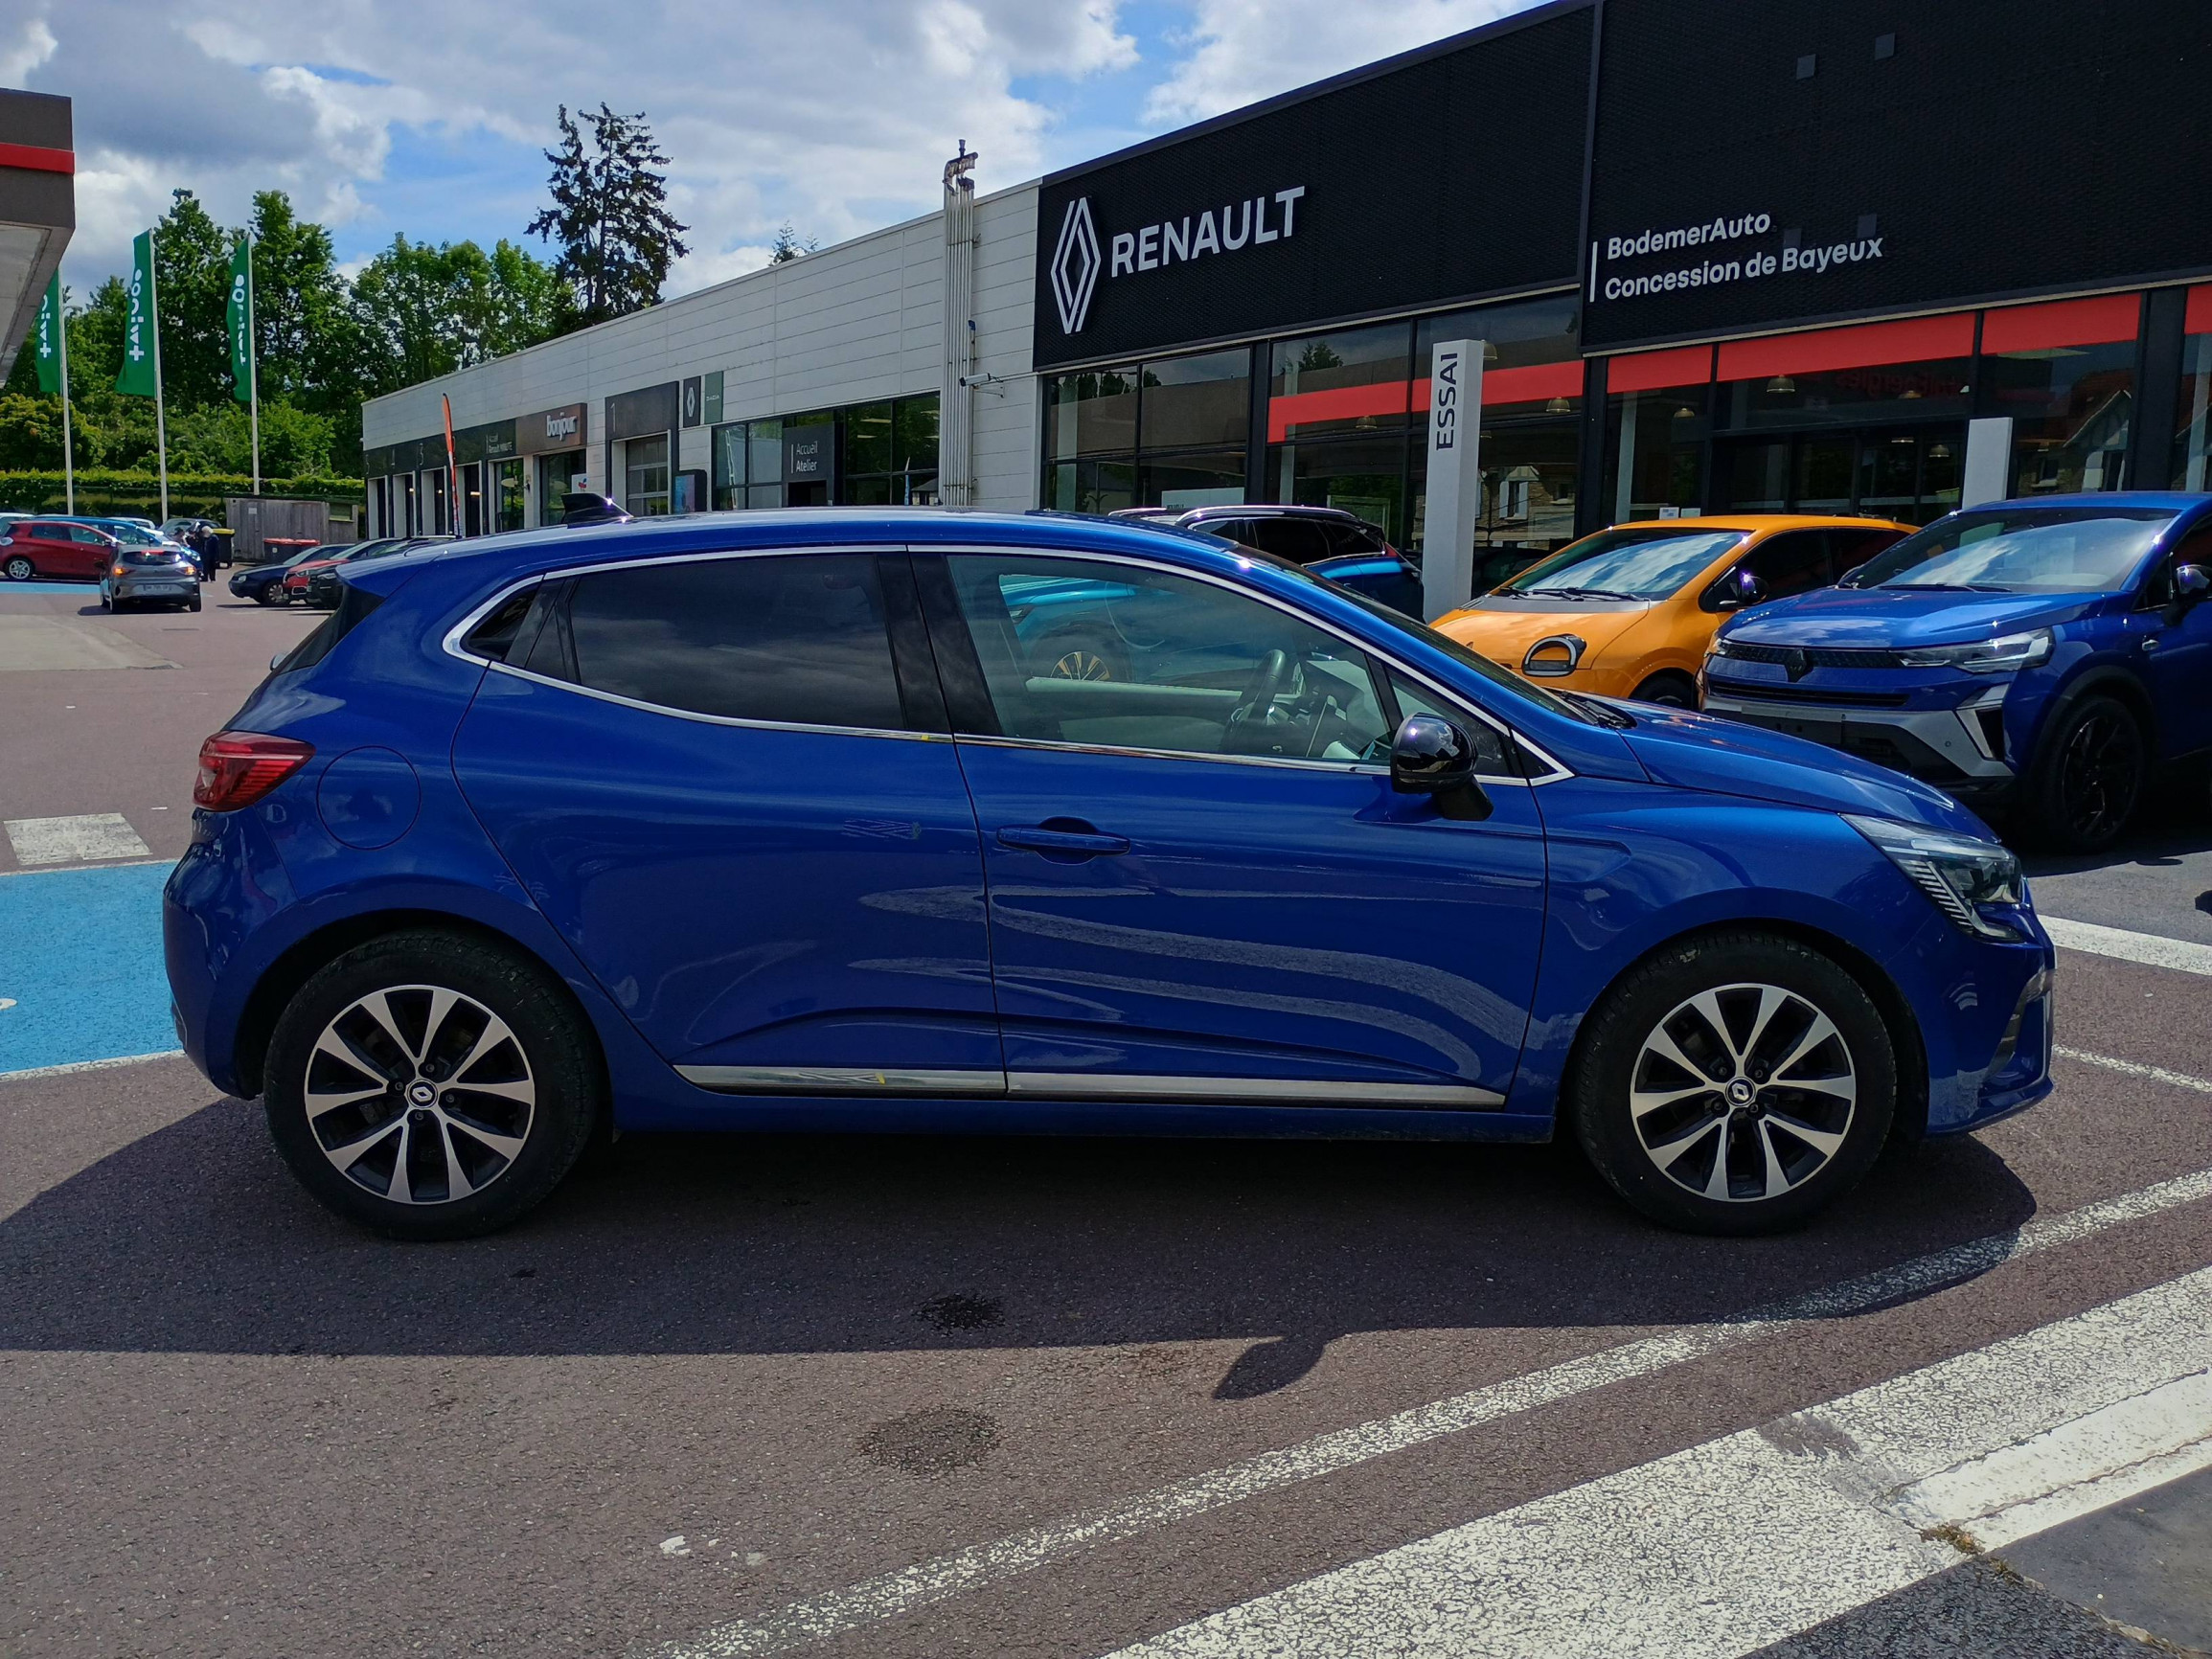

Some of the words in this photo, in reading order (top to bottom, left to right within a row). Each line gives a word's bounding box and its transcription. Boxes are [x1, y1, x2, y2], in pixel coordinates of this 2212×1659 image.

[1111, 185, 1306, 279] RENAULT
[1607, 213, 1771, 261] BodemerAuto
[1605, 261, 1742, 301] Concession
[1745, 251, 1778, 278] de
[1781, 238, 1884, 274] Bayeux
[1435, 352, 1458, 452] ESSAI
[546, 411, 578, 442] bonjour
[795, 440, 819, 456] Accueil
[795, 459, 818, 473] Atelier
